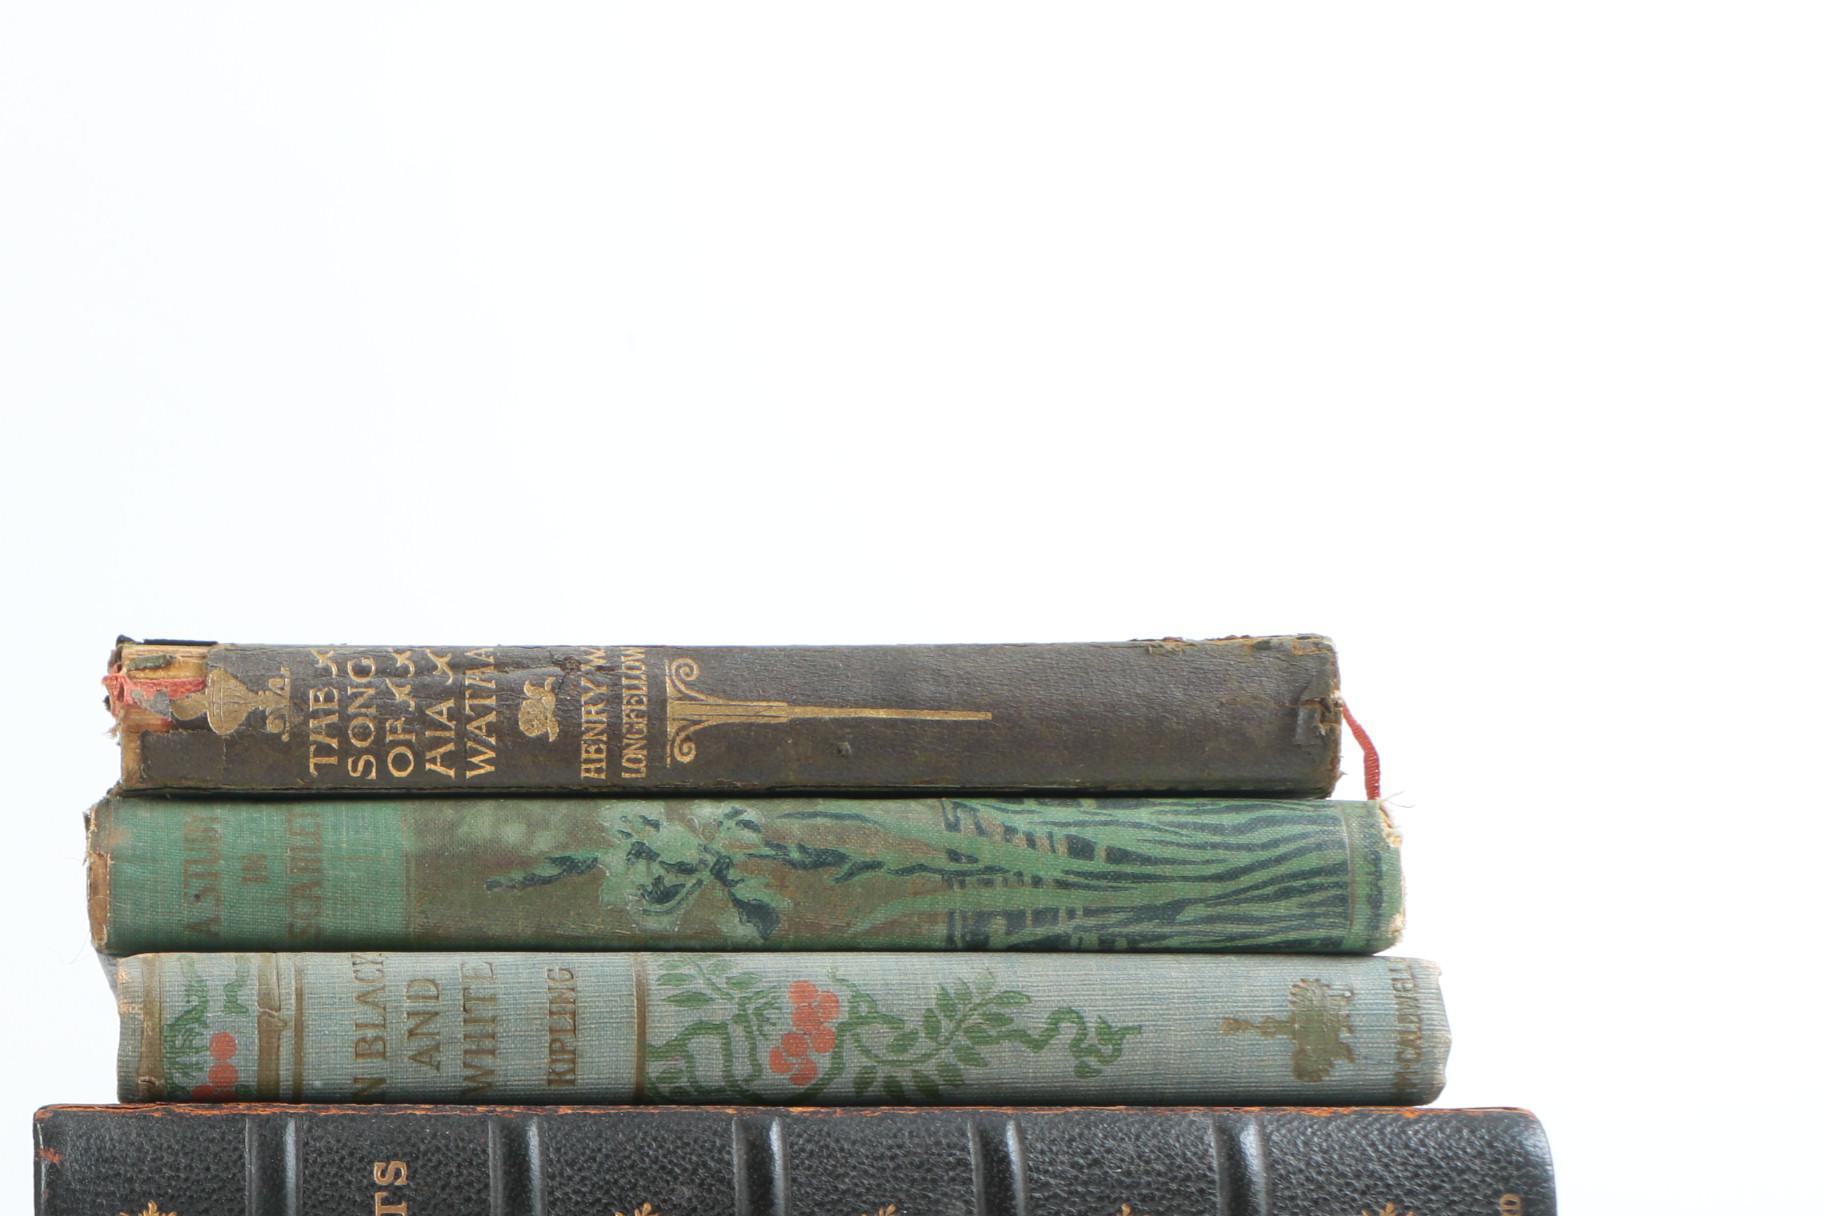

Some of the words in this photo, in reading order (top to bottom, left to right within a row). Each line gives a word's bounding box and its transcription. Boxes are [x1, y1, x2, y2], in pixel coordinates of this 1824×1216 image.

[347, 656, 377, 780] SONG
[386, 714, 415, 778] OF
[621, 647, 647, 779] LONGFELLOW
[350, 954, 386, 1060] BLACK
[404, 978, 441, 1071] AND
[460, 961, 497, 1096] WHITE
[546, 968, 576, 1088] KIPLING
